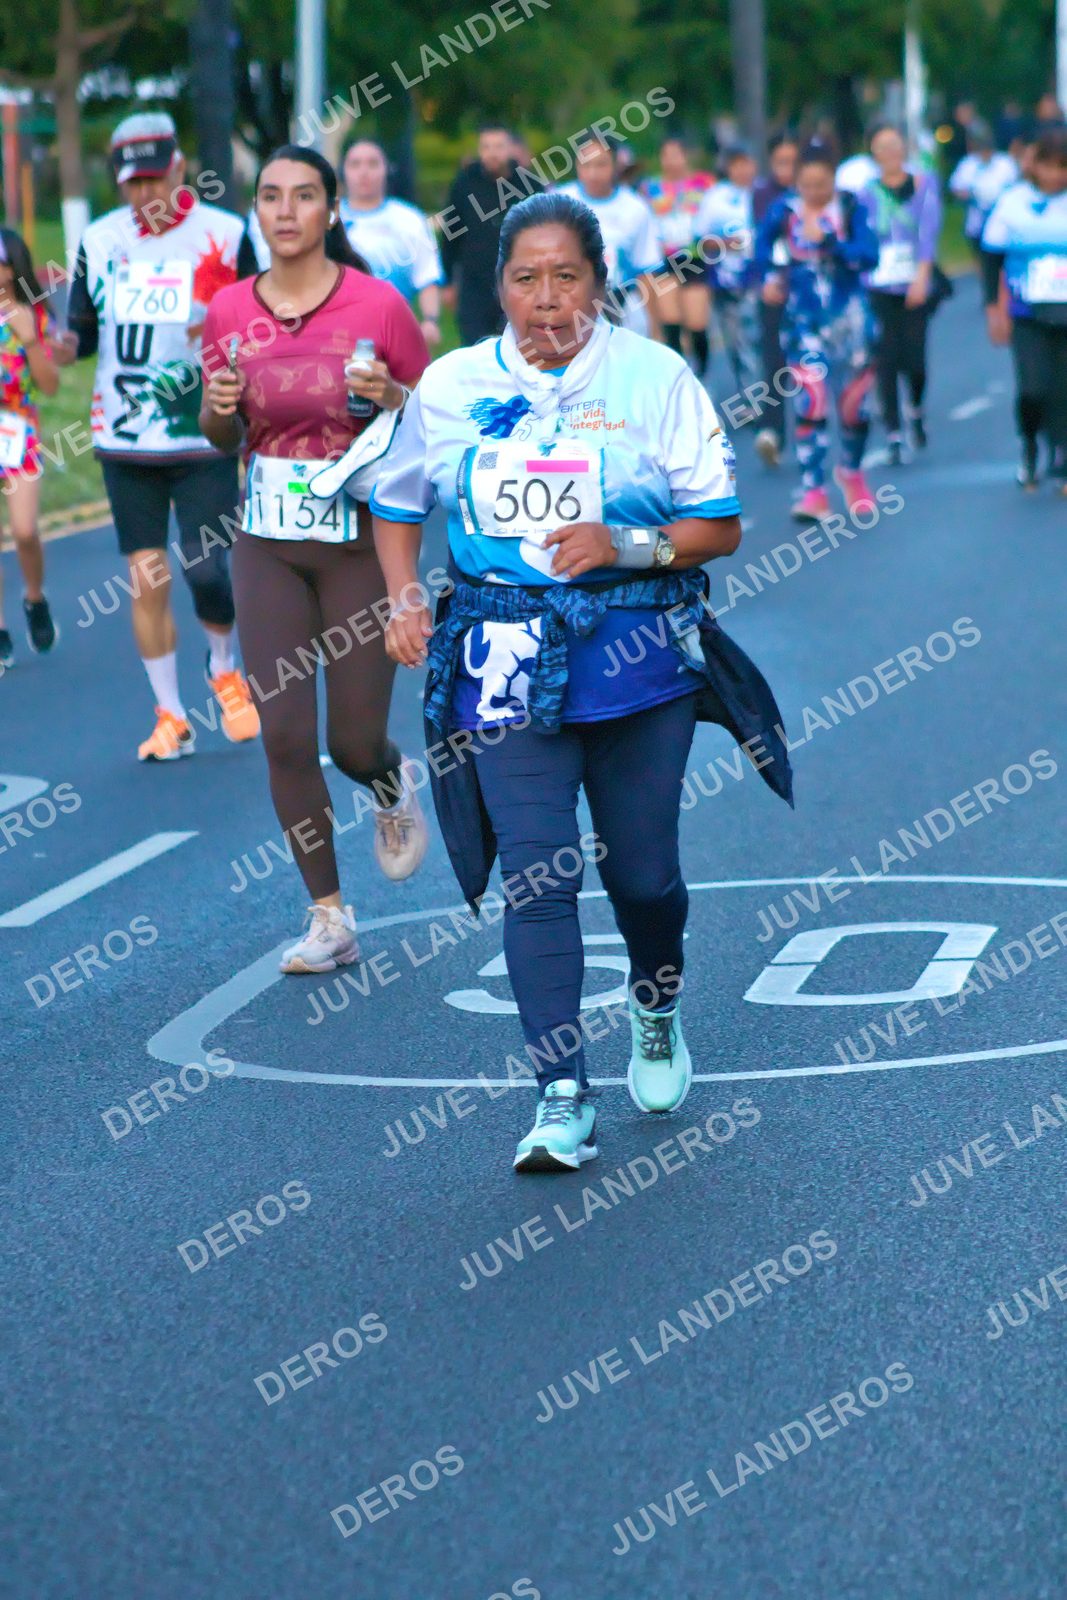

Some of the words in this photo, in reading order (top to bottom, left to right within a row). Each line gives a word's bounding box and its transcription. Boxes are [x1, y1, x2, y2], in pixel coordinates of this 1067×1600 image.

[126, 287, 179, 315] 760
[560, 399, 606, 414] arrera
[255, 491, 341, 531] 1154
[493, 478, 582, 523] 506
